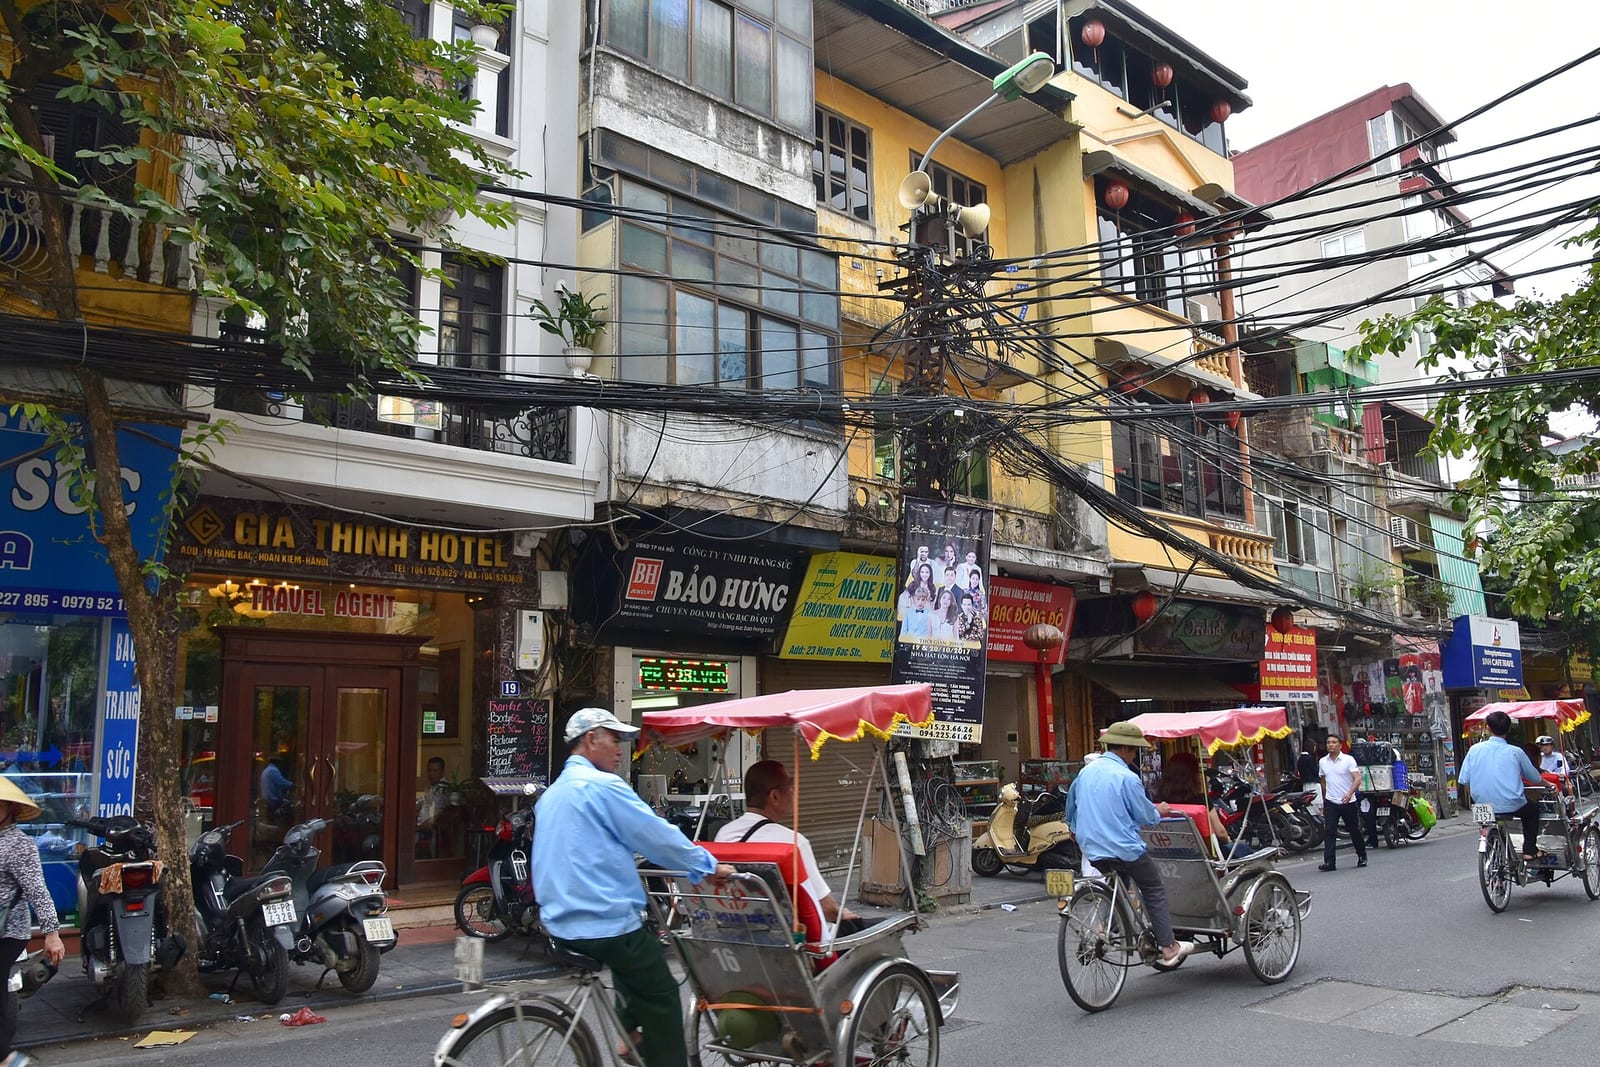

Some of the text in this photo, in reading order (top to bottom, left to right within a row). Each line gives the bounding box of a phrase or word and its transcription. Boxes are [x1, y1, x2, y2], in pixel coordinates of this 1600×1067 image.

[234, 511, 296, 549] GIA
[311, 518, 409, 559] THINH
[420, 531, 508, 568] HOTEL
[709, 551, 722, 560] TY
[748, 556, 777, 568] TRANG
[633, 563, 660, 585] BH
[664, 564, 789, 613] BẢO HƯNG
[838, 578, 894, 603] MADE IN
[24, 594, 49, 607] 895
[61, 595, 94, 609] 0979
[97, 598, 113, 610] 52
[250, 585, 396, 620] TRAVEL AGENT
[801, 601, 846, 619] TRADESMAN
[992, 604, 1014, 626] BẠC
[1014, 603, 1046, 625] ĐÔNG
[806, 645, 816, 656] 23
[929, 645, 971, 655] 20/10/2017
[504, 683, 517, 695] 19
[105, 690, 138, 720] TRANG
[919, 730, 973, 740] 094.225.61.62
[107, 740, 130, 779] SỨC
[1158, 862, 1181, 879] 82
[711, 947, 741, 973] 16
